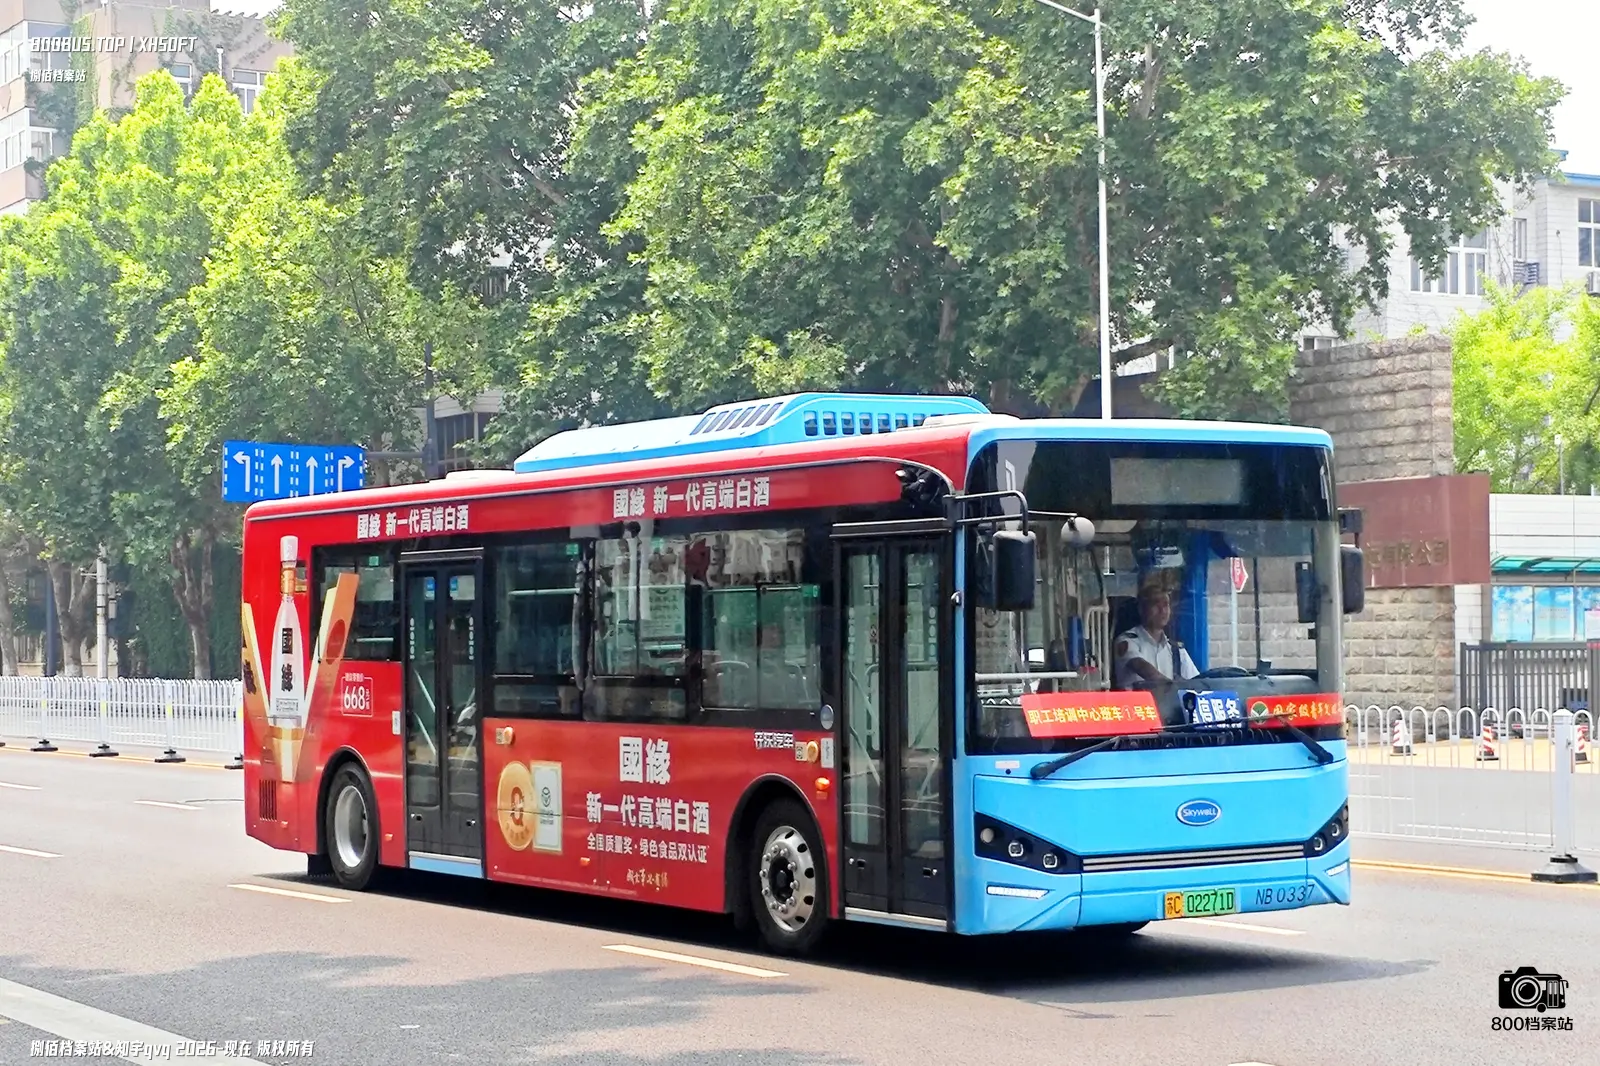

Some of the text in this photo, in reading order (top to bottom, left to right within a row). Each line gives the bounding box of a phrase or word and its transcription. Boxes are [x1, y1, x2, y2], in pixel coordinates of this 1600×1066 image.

[653, 477, 770, 514] 新一代高端白酒
[385, 504, 469, 536] 新一代高端白酒
[344, 686, 366, 710] 668
[1192, 697, 1240, 724] 信服务
[586, 791, 710, 835] 新一代高端白酒
[1256, 884, 1315, 905] NB 0337
